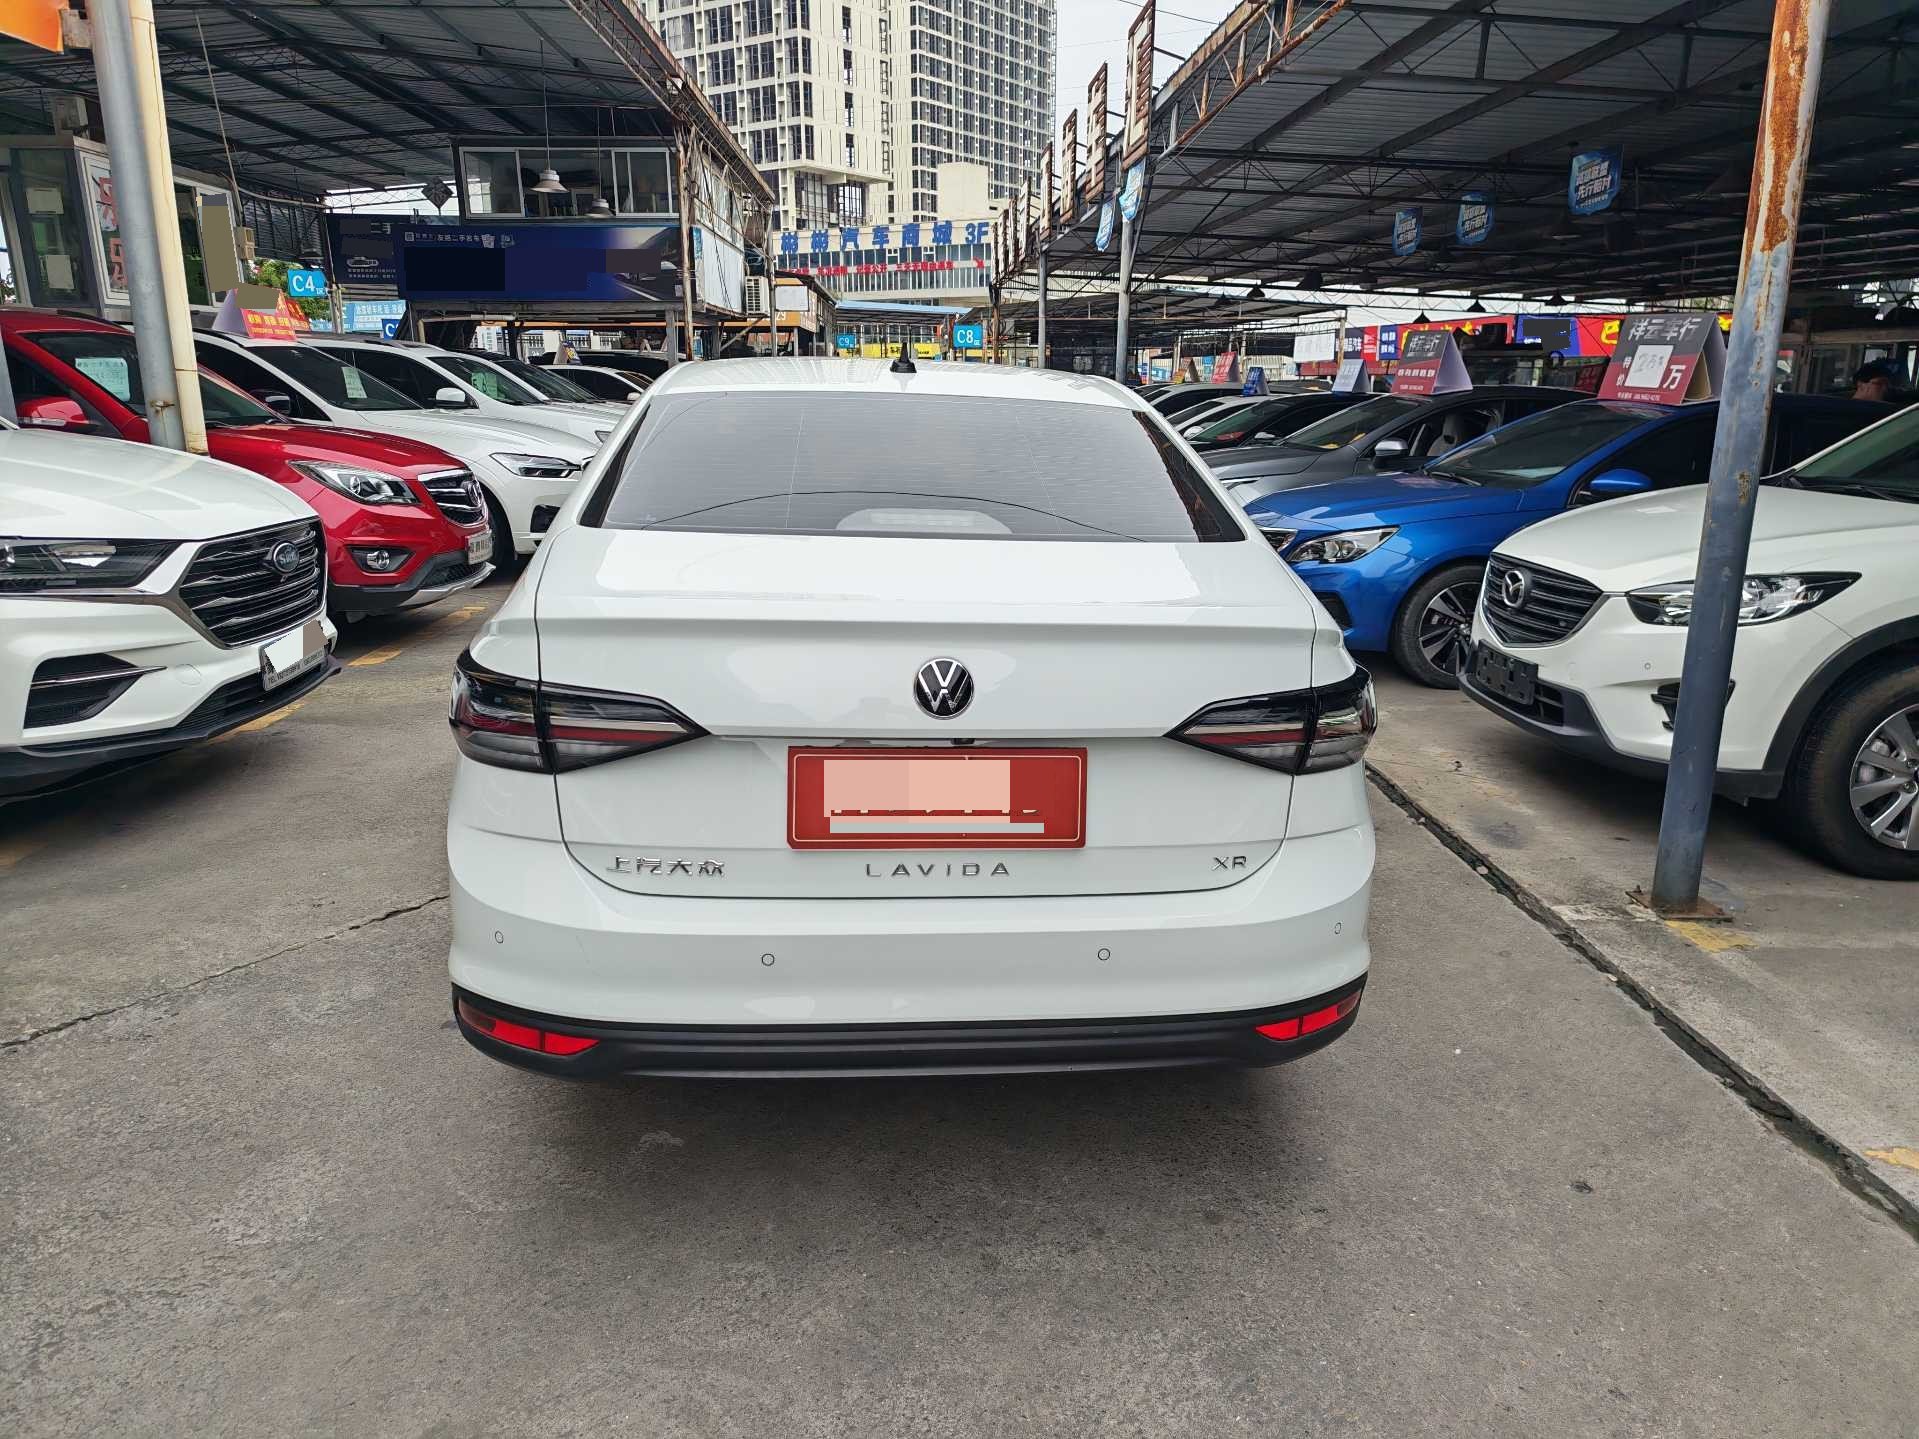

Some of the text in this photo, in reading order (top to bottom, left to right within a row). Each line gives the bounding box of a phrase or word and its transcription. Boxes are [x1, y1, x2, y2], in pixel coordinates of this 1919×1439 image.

[780, 220, 990, 254] 彬彬汽车商城 3F
[1628, 317, 1702, 341] 祥云车行
[1662, 364, 1686, 390] 万
[607, 855, 725, 877] 上汽大众
[865, 862, 1012, 878] LAVIDA
[1212, 854, 1248, 870] XR
